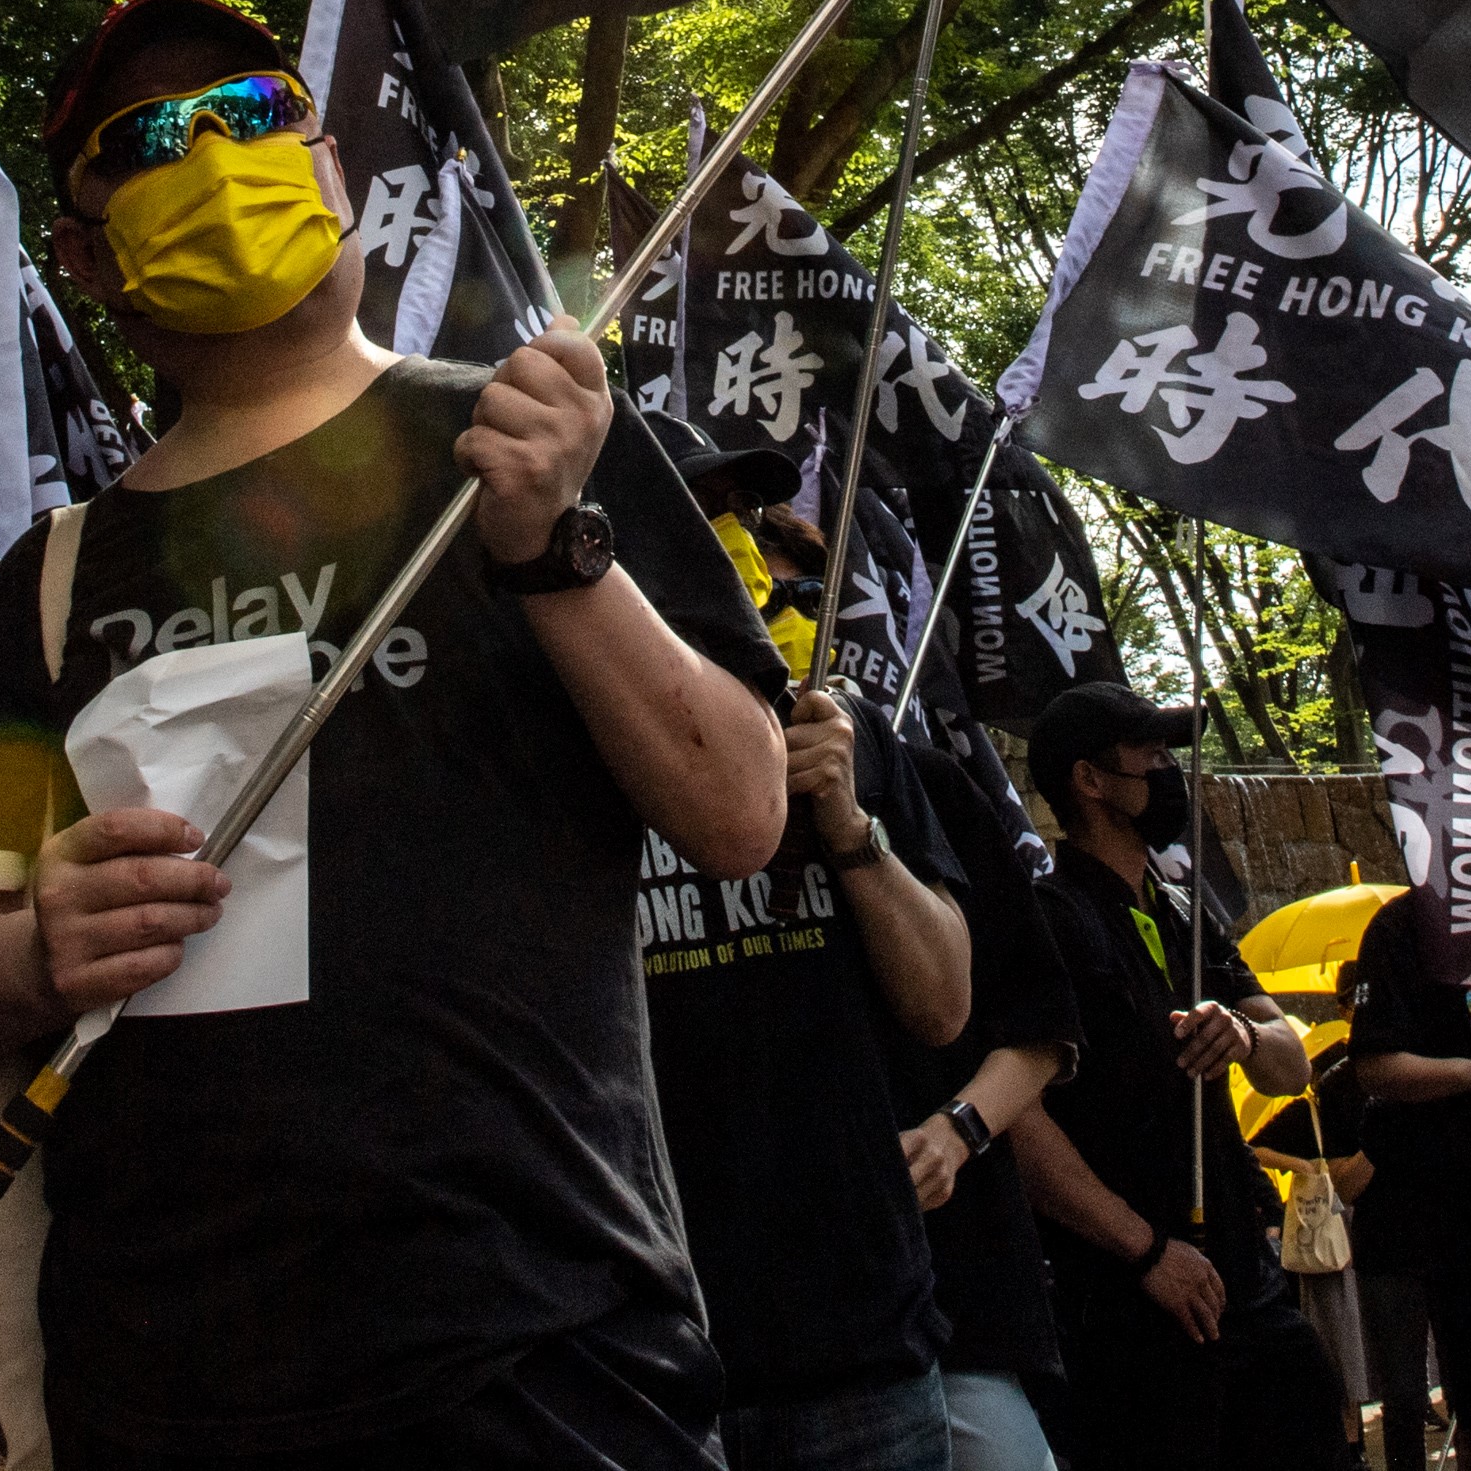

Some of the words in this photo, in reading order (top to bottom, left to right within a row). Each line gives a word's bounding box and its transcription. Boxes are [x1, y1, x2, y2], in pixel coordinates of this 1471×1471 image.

[716, 269, 784, 301] FREE
[1140, 242, 1264, 301] FREE
[1278, 275, 1429, 327] HONG
[632, 314, 677, 348] FR
[89, 561, 338, 678] Relay
[634, 882, 706, 948] ONG
[719, 862, 835, 932] KOG
[643, 947, 713, 978] VOLUTION
[716, 941, 736, 965] OF
[741, 933, 775, 958] OUR
[779, 927, 827, 954] TIMES
